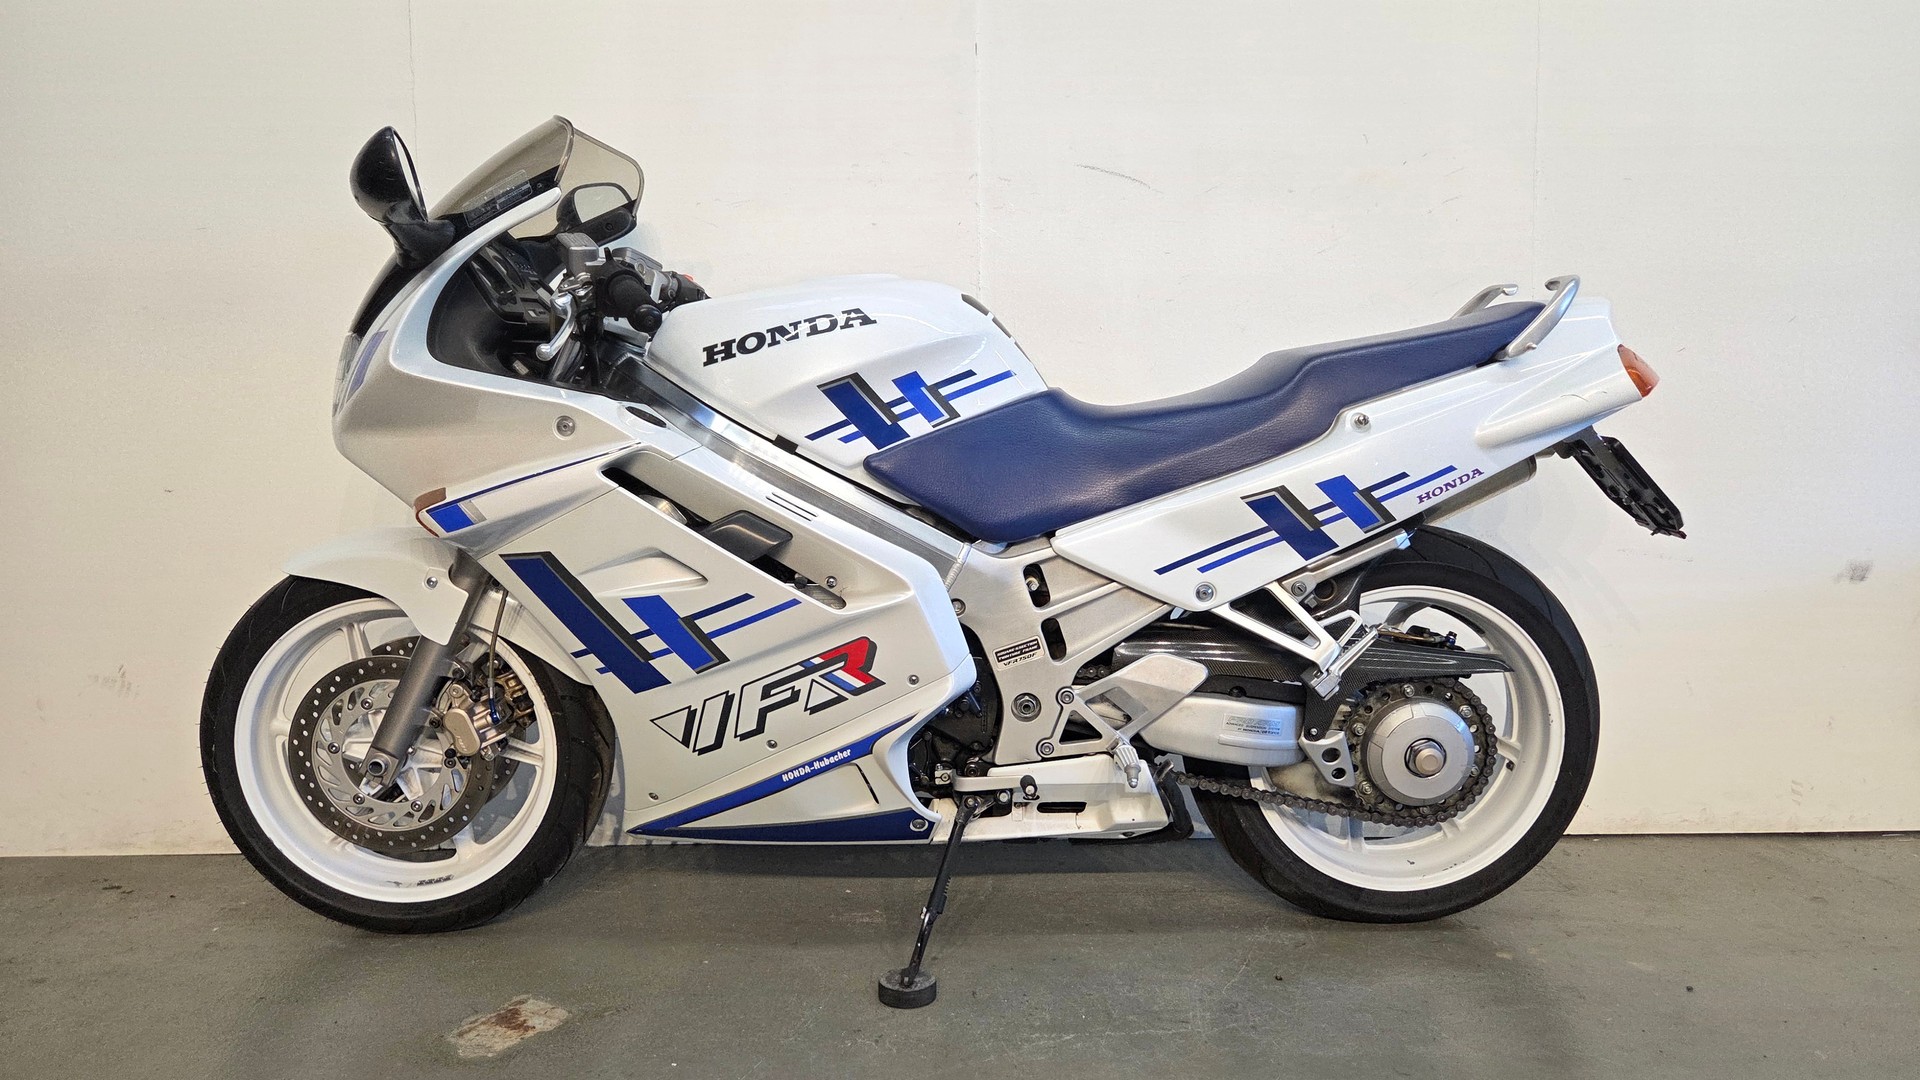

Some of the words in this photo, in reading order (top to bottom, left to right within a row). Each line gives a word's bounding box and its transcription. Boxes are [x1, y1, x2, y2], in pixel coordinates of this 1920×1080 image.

[703, 308, 877, 367] HONDA
[1416, 468, 1485, 504] HONDA
[649, 636, 887, 756] VFR
[781, 748, 851, 782] HONDA-Hubacher
